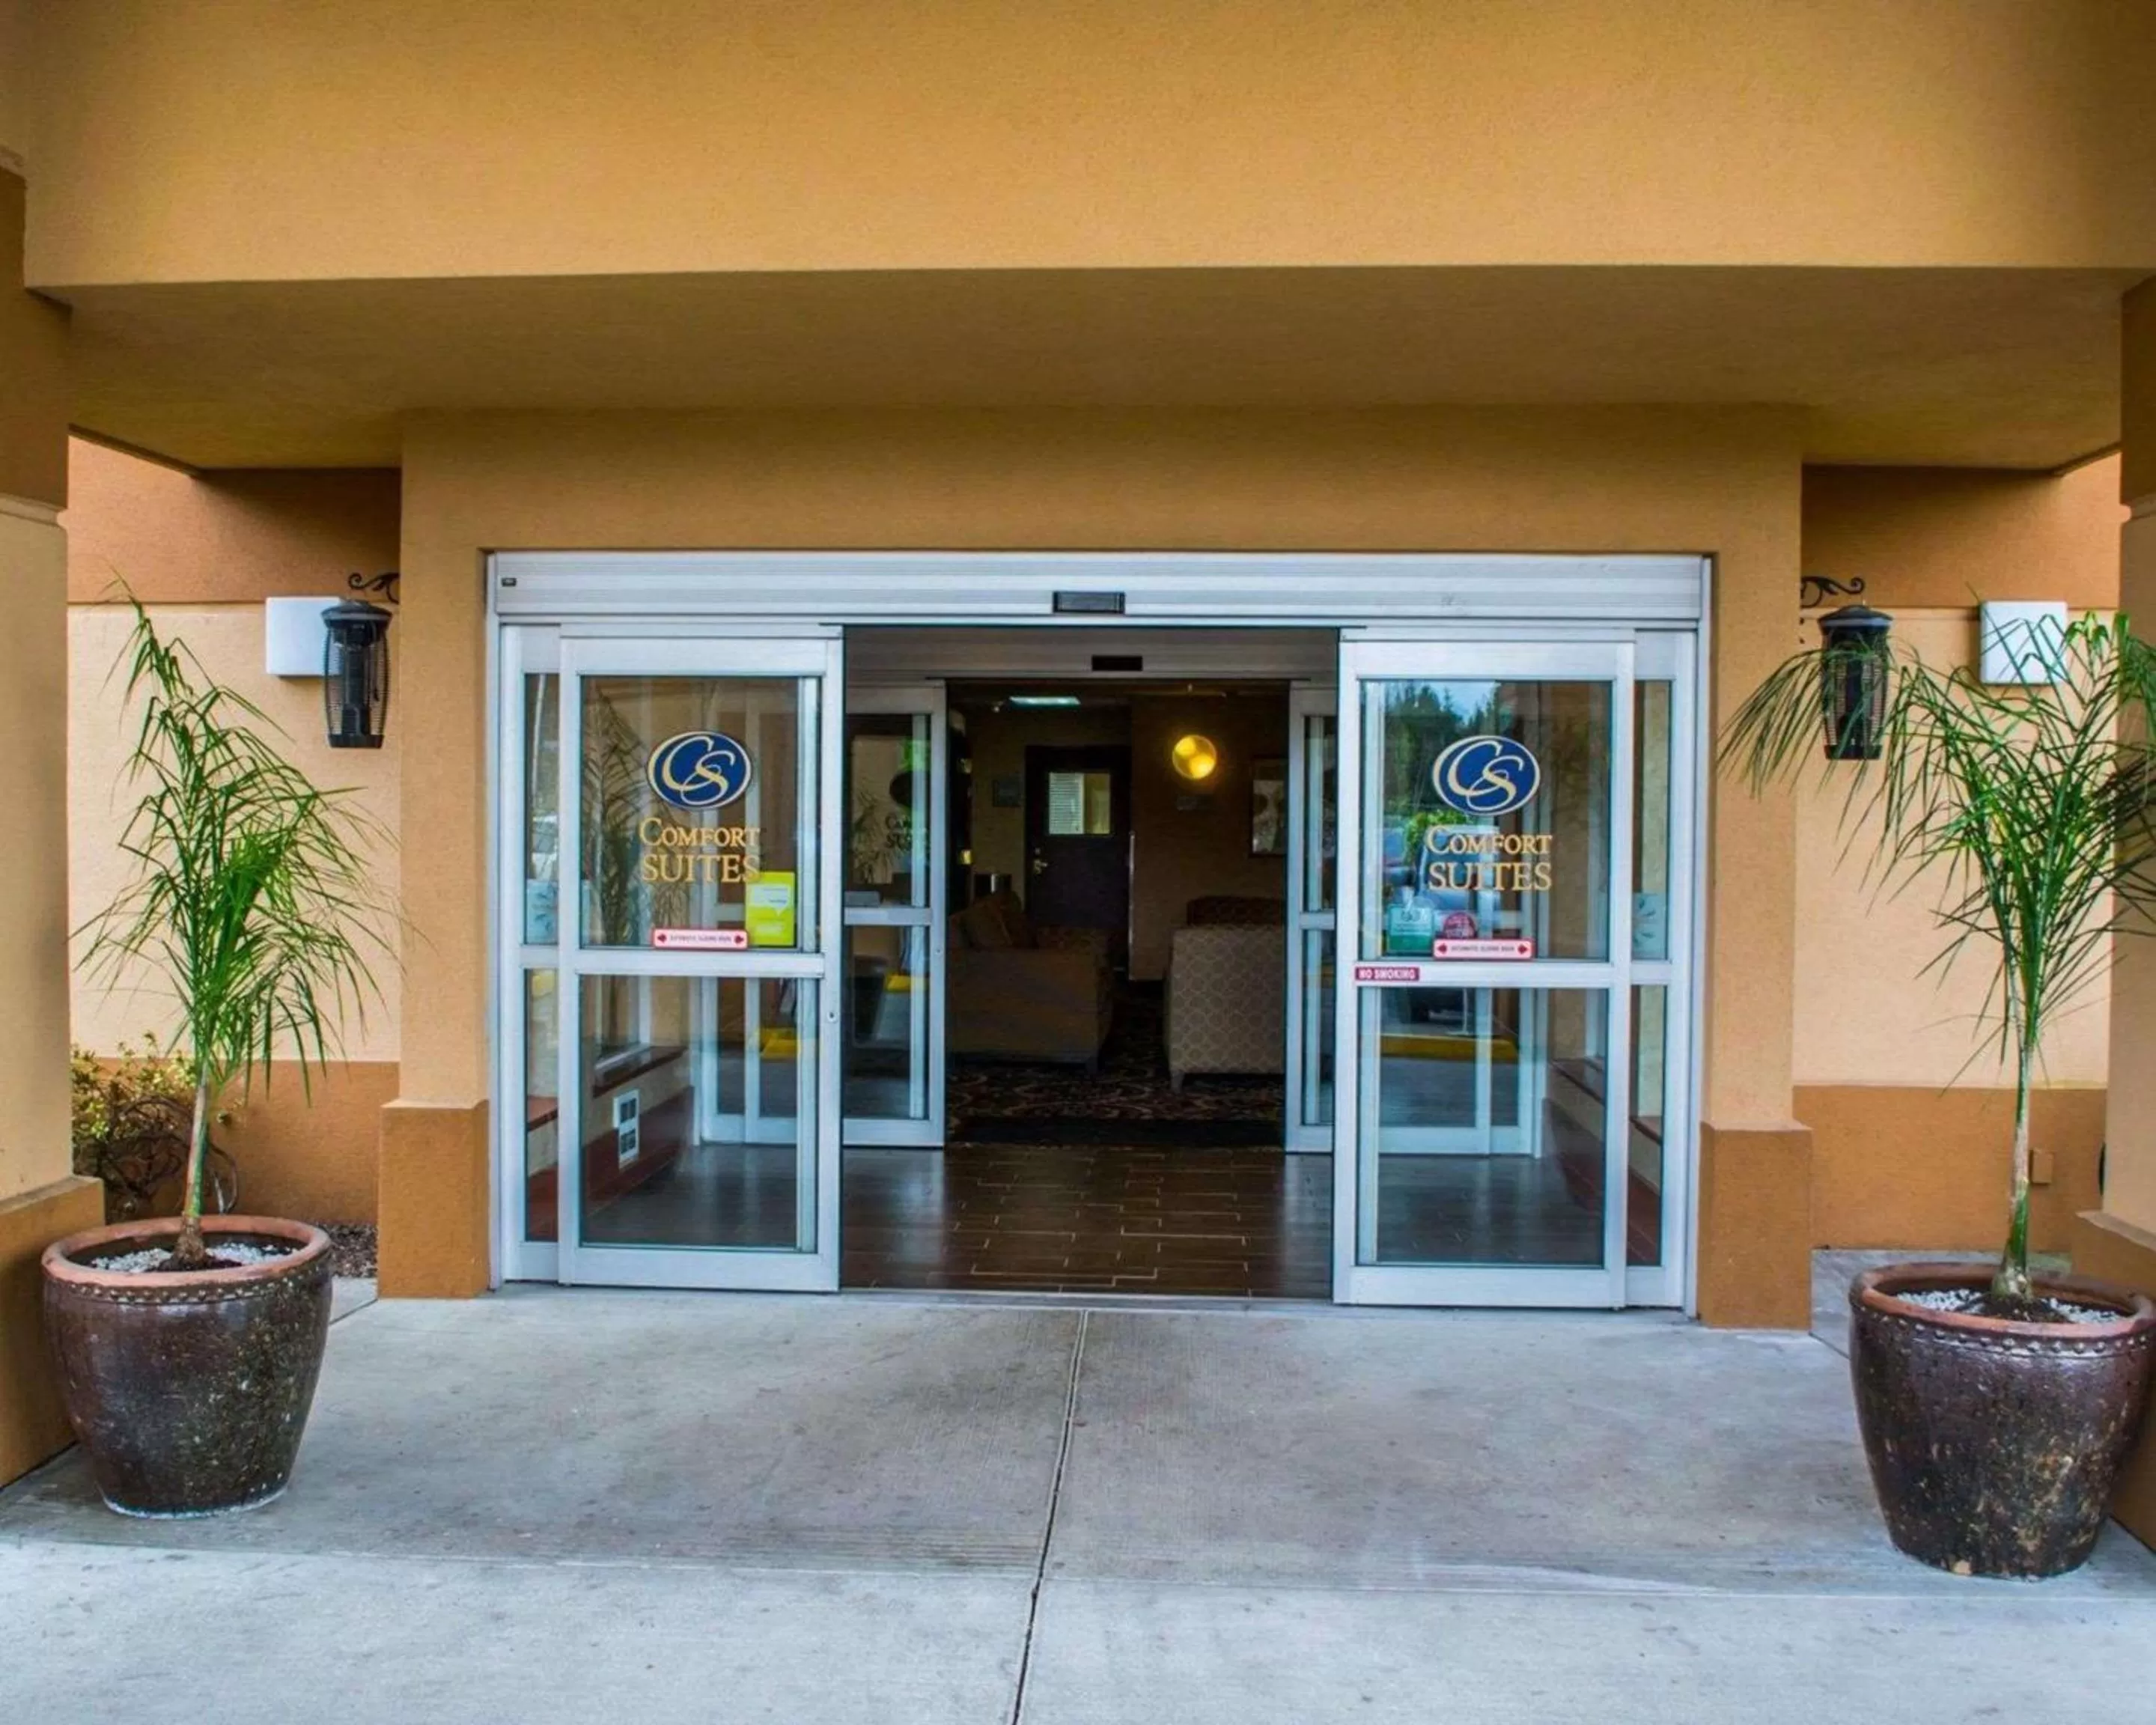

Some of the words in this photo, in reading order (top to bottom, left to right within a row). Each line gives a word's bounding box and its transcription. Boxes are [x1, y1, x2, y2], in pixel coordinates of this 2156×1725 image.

[639, 818, 761, 847] COMFORT
[1426, 825, 1553, 855] COMFORT
[642, 853, 761, 883] SUITES
[1428, 862, 1552, 891] SUITES
[1359, 968, 1372, 980] NO
[1374, 968, 1416, 981] SMOKING
